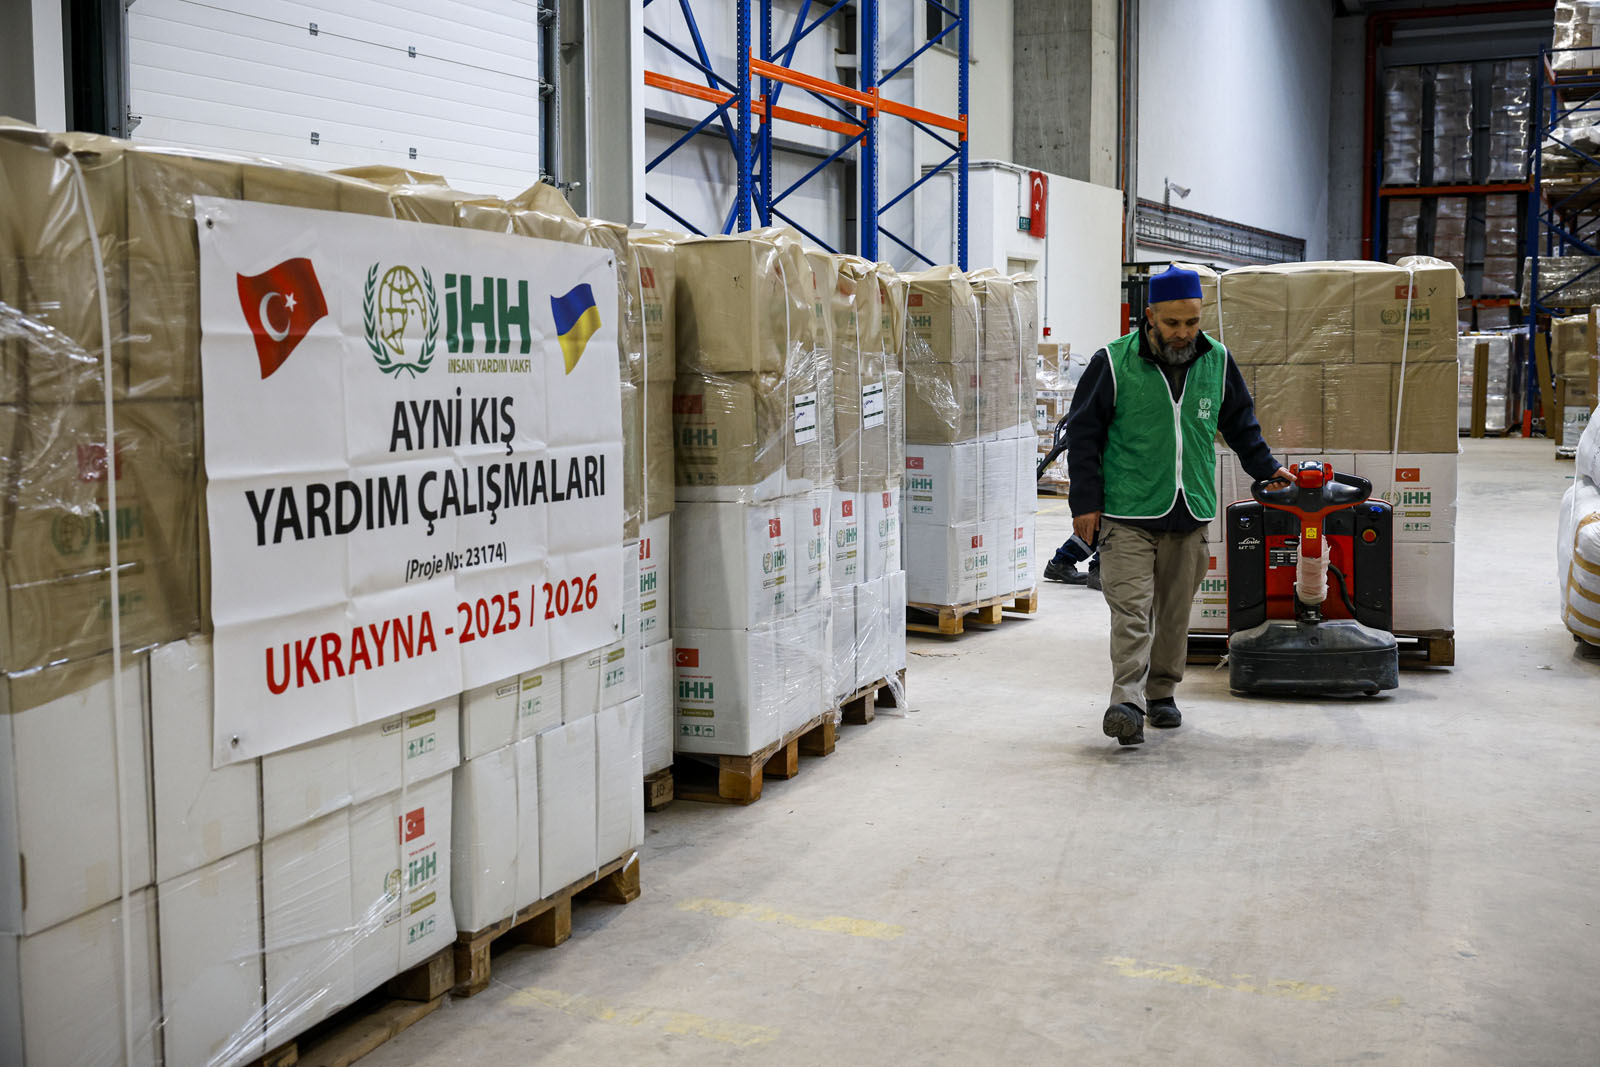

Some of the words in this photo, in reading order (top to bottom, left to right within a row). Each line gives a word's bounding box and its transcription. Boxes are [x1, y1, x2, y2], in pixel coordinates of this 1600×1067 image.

[476, 359, 507, 373] YARDIM
[389, 386, 461, 452] AYNİ
[471, 396, 515, 456] KIŞ
[245, 475, 409, 546] YARDIM
[418, 454, 605, 536] ÇALIŞMALARI
[266, 611, 437, 695] UKRAYNA
[542, 573, 598, 621] 2026
